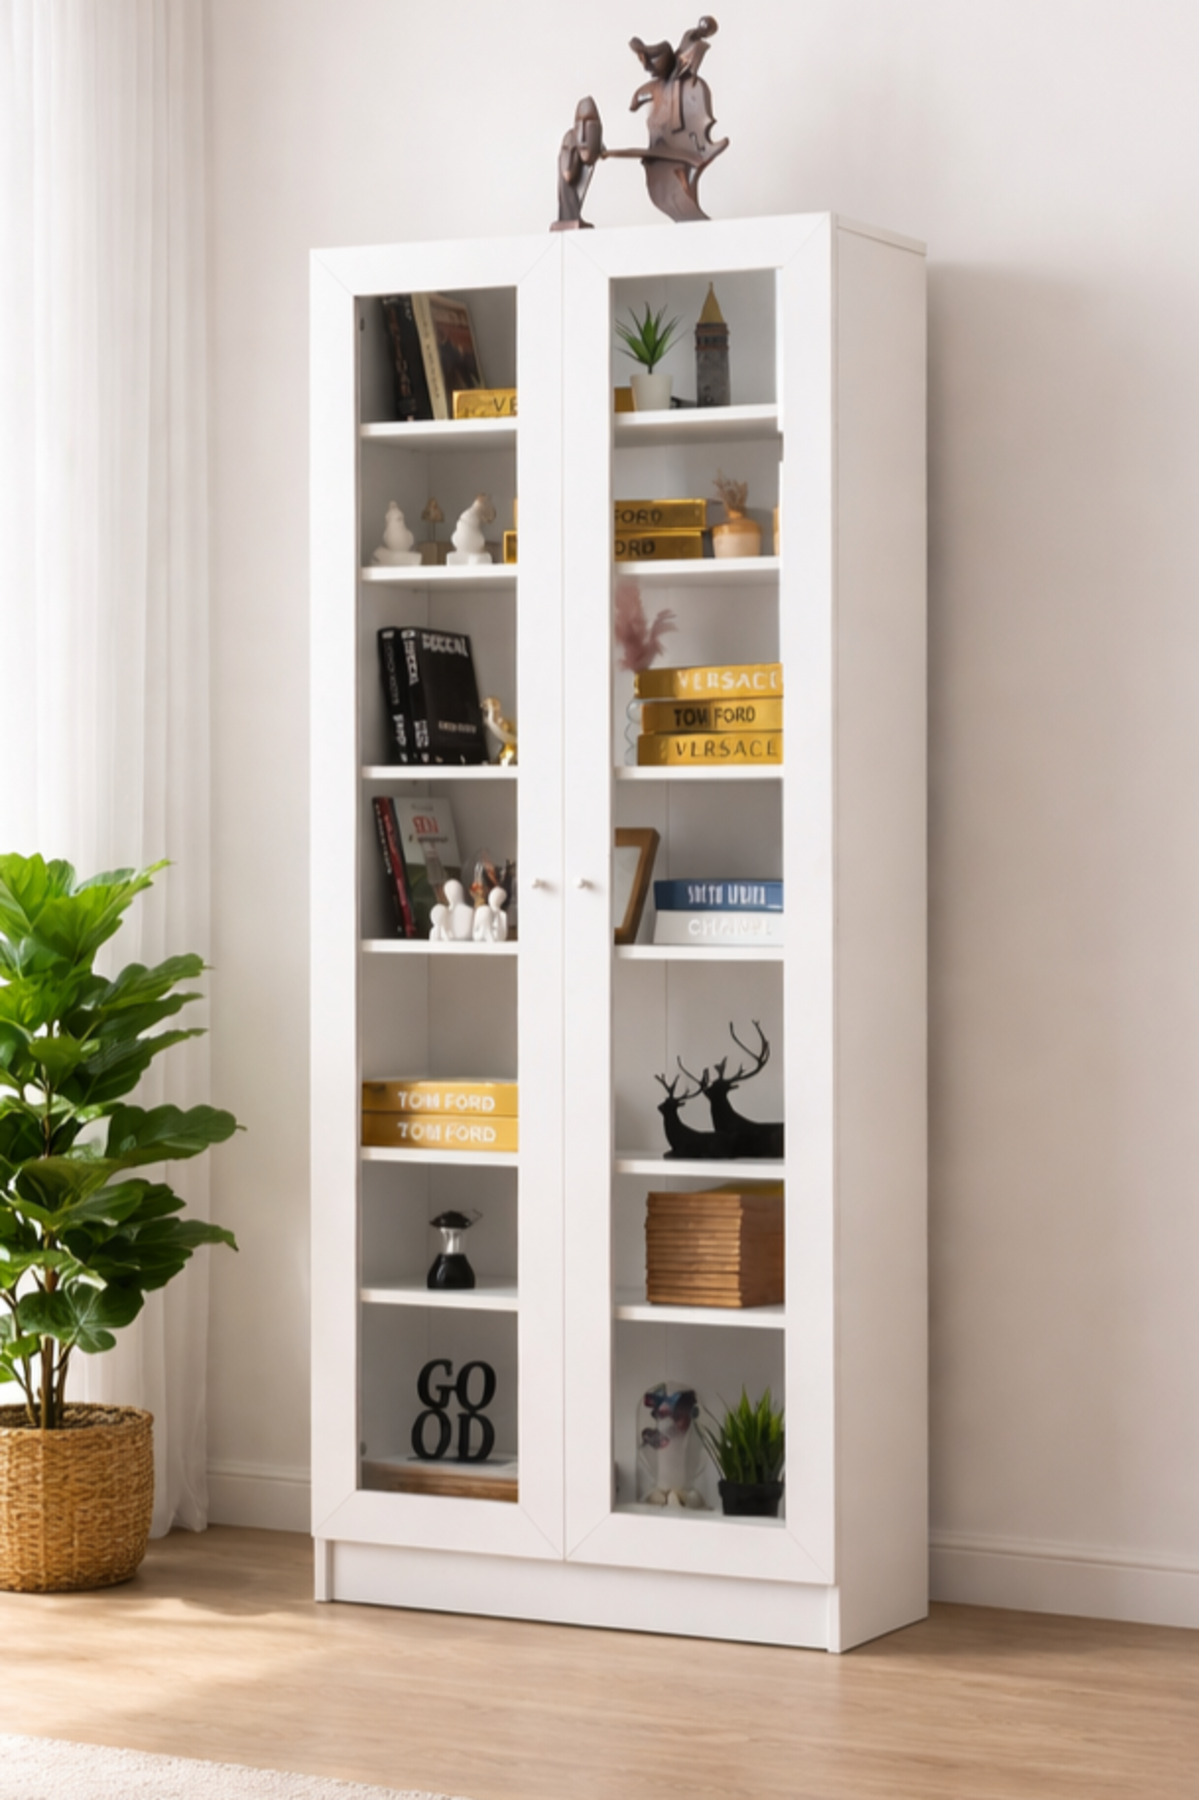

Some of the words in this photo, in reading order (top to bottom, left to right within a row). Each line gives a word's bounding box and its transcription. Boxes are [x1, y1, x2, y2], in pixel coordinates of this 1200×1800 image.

[714, 705, 756, 725] FORD
[398, 1091, 440, 1110] TOM
[445, 1093, 495, 1112] FORD
[397, 1121, 441, 1141] TOM
[445, 1123, 497, 1142] FORD
